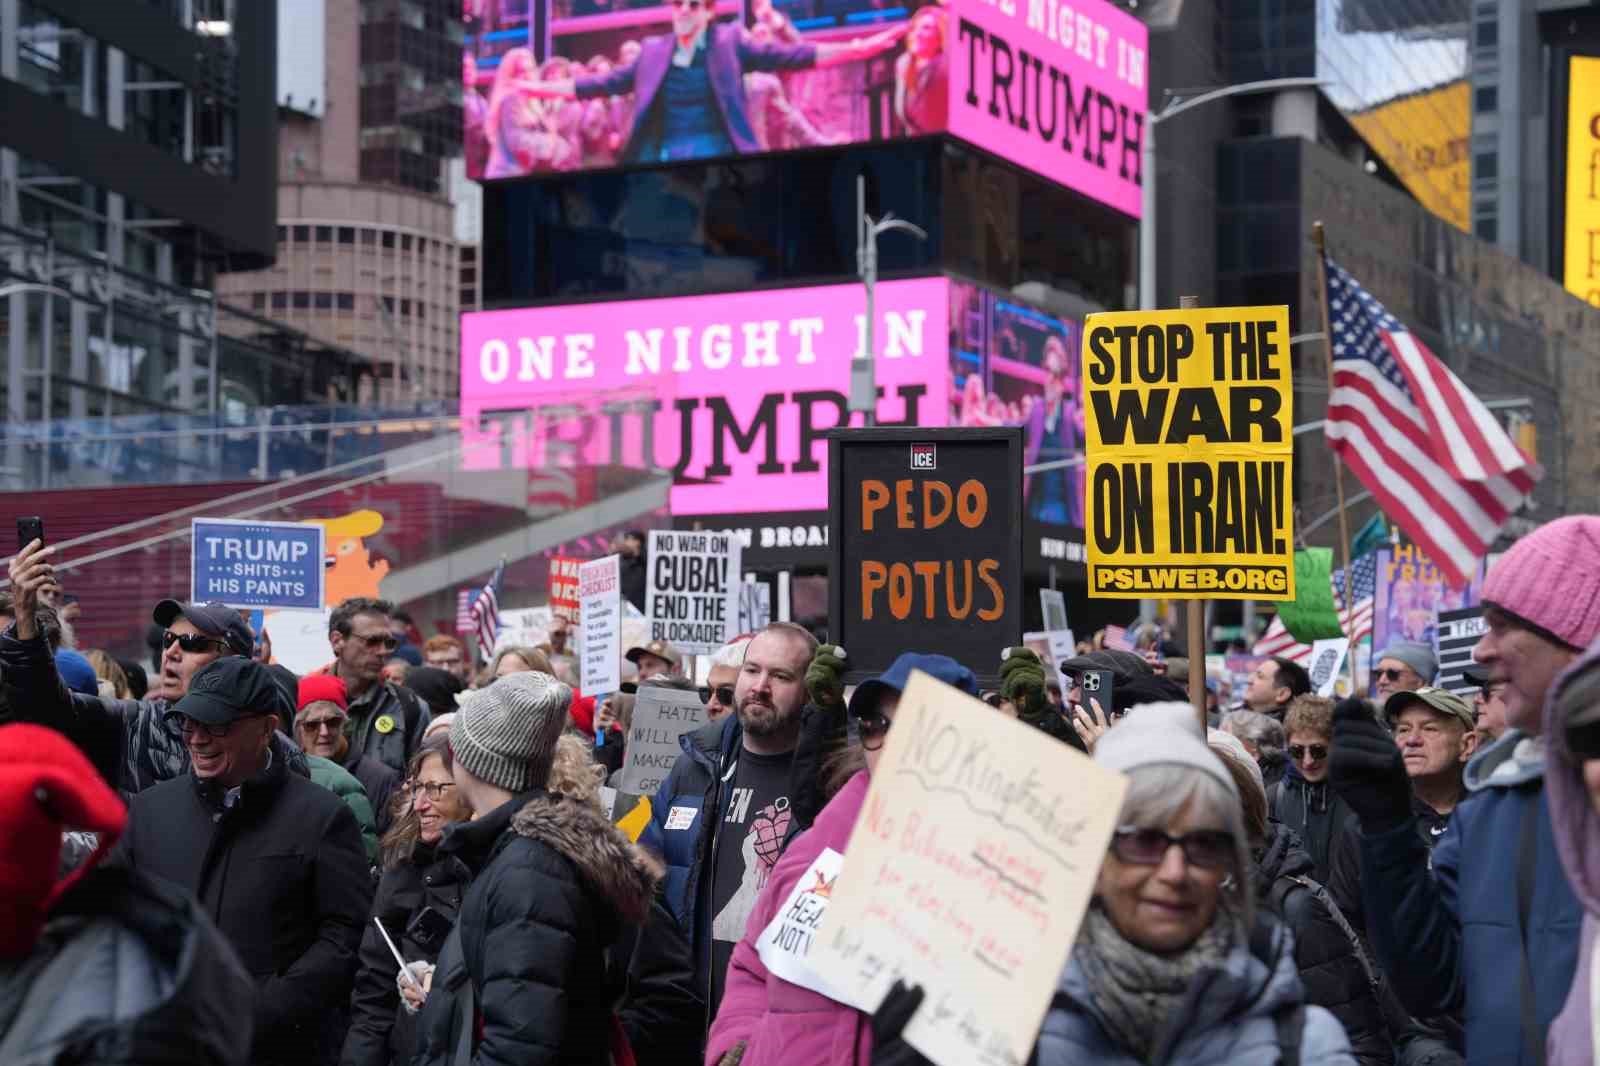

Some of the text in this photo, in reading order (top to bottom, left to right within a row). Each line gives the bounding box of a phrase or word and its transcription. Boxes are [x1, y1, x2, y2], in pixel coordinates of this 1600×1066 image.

[1026, 0, 1145, 90] NIGHT IN
[958, 16, 1143, 186] TRIUMPH
[479, 309, 926, 384] ONE NIGHT IN
[1089, 320, 1280, 385] STOP THE
[1090, 386, 1283, 445] WAR
[914, 452, 934, 467] ICE
[861, 479, 988, 531] PEDO
[1093, 461, 1287, 555] ON IRAN!
[205, 537, 309, 562] TRUMP
[656, 535, 728, 553] NO WAR ON
[233, 562, 281, 577] SHITS
[655, 555, 728, 594] CUBA!
[1097, 567, 1287, 591] PSLWEB.ORG
[208, 579, 305, 596] HIS PANTS
[860, 559, 1005, 621] POTUS
[653, 595, 688, 620] END
[693, 596, 726, 622] THE
[652, 621, 726, 644] BLOCKADE!
[658, 705, 702, 722] HATE
[634, 727, 673, 745] WILL
[633, 752, 675, 769] MAKE
[772, 924, 806, 955] NOT
